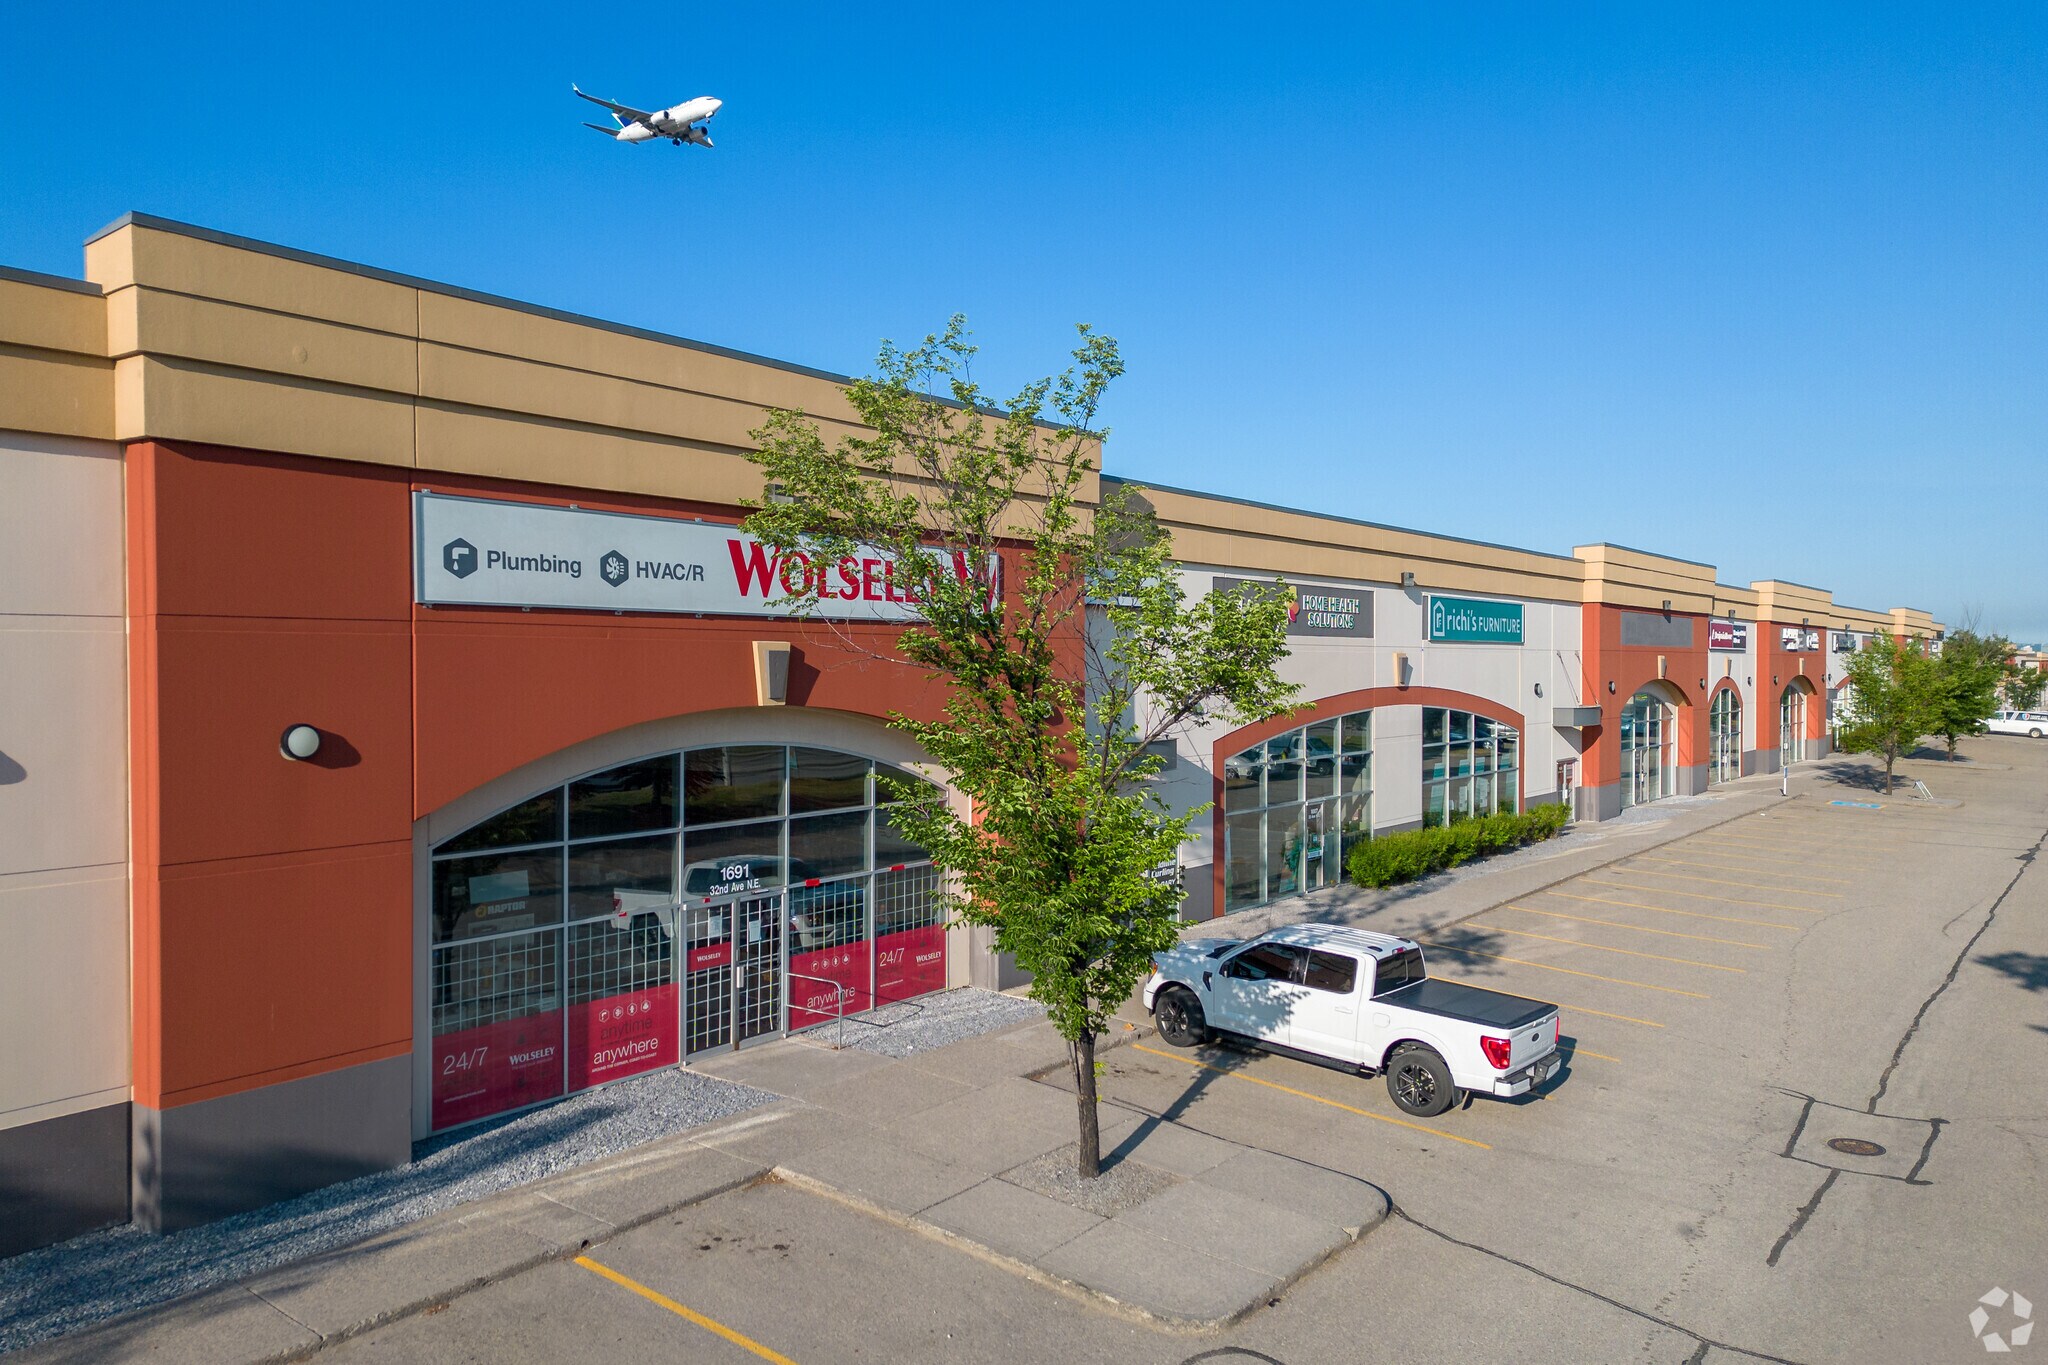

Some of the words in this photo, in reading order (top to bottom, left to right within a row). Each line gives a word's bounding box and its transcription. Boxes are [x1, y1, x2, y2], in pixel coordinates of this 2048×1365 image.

[487, 550, 582, 578] Plumbing
[636, 561, 705, 582] HVAC/R
[727, 539, 944, 604] WOLSEL
[1302, 595, 1328, 611] HOME
[1328, 597, 1360, 613] HEALTH
[1308, 612, 1355, 629] SOLUTIONS
[1447, 608, 1477, 631] richi's
[1479, 616, 1521, 633] FURNITURE
[720, 864, 749, 880] 1691
[1151, 868, 1175, 878] Curling
[710, 883, 729, 895] 32nd
[731, 882, 744, 892] Ave
[747, 879, 761, 889] N.E.
[488, 901, 526, 915] RAPTOR
[697, 952, 721, 962] WOLSELEY
[880, 948, 904, 966] 24/7
[916, 951, 942, 963] WOLSELEY
[601, 1018, 652, 1040] anytime
[443, 1046, 488, 1075] 24/7
[509, 1046, 555, 1065] WOLSELEY
[593, 1038, 658, 1065] anywhere
